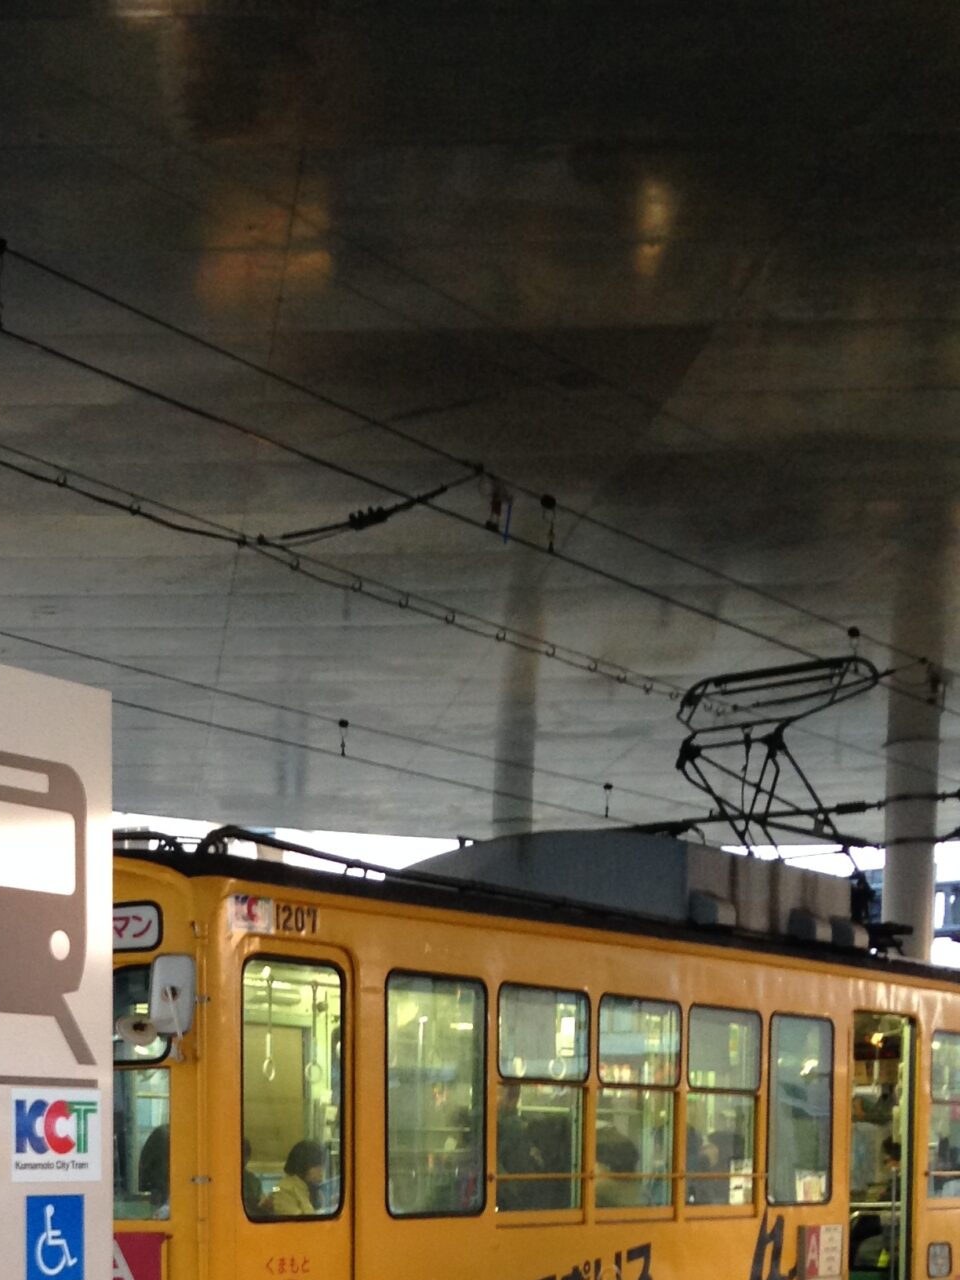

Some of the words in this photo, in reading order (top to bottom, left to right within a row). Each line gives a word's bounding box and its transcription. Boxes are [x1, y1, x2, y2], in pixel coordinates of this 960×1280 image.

[275, 903, 320, 934] 1207
[15, 1099, 97, 1155] KCT
[15, 1160, 54, 1170] Kumamoto
[56, 1160, 70, 1171] City
[71, 1160, 89, 1170] Tram
[265, 1256, 310, 1276] くまもと
